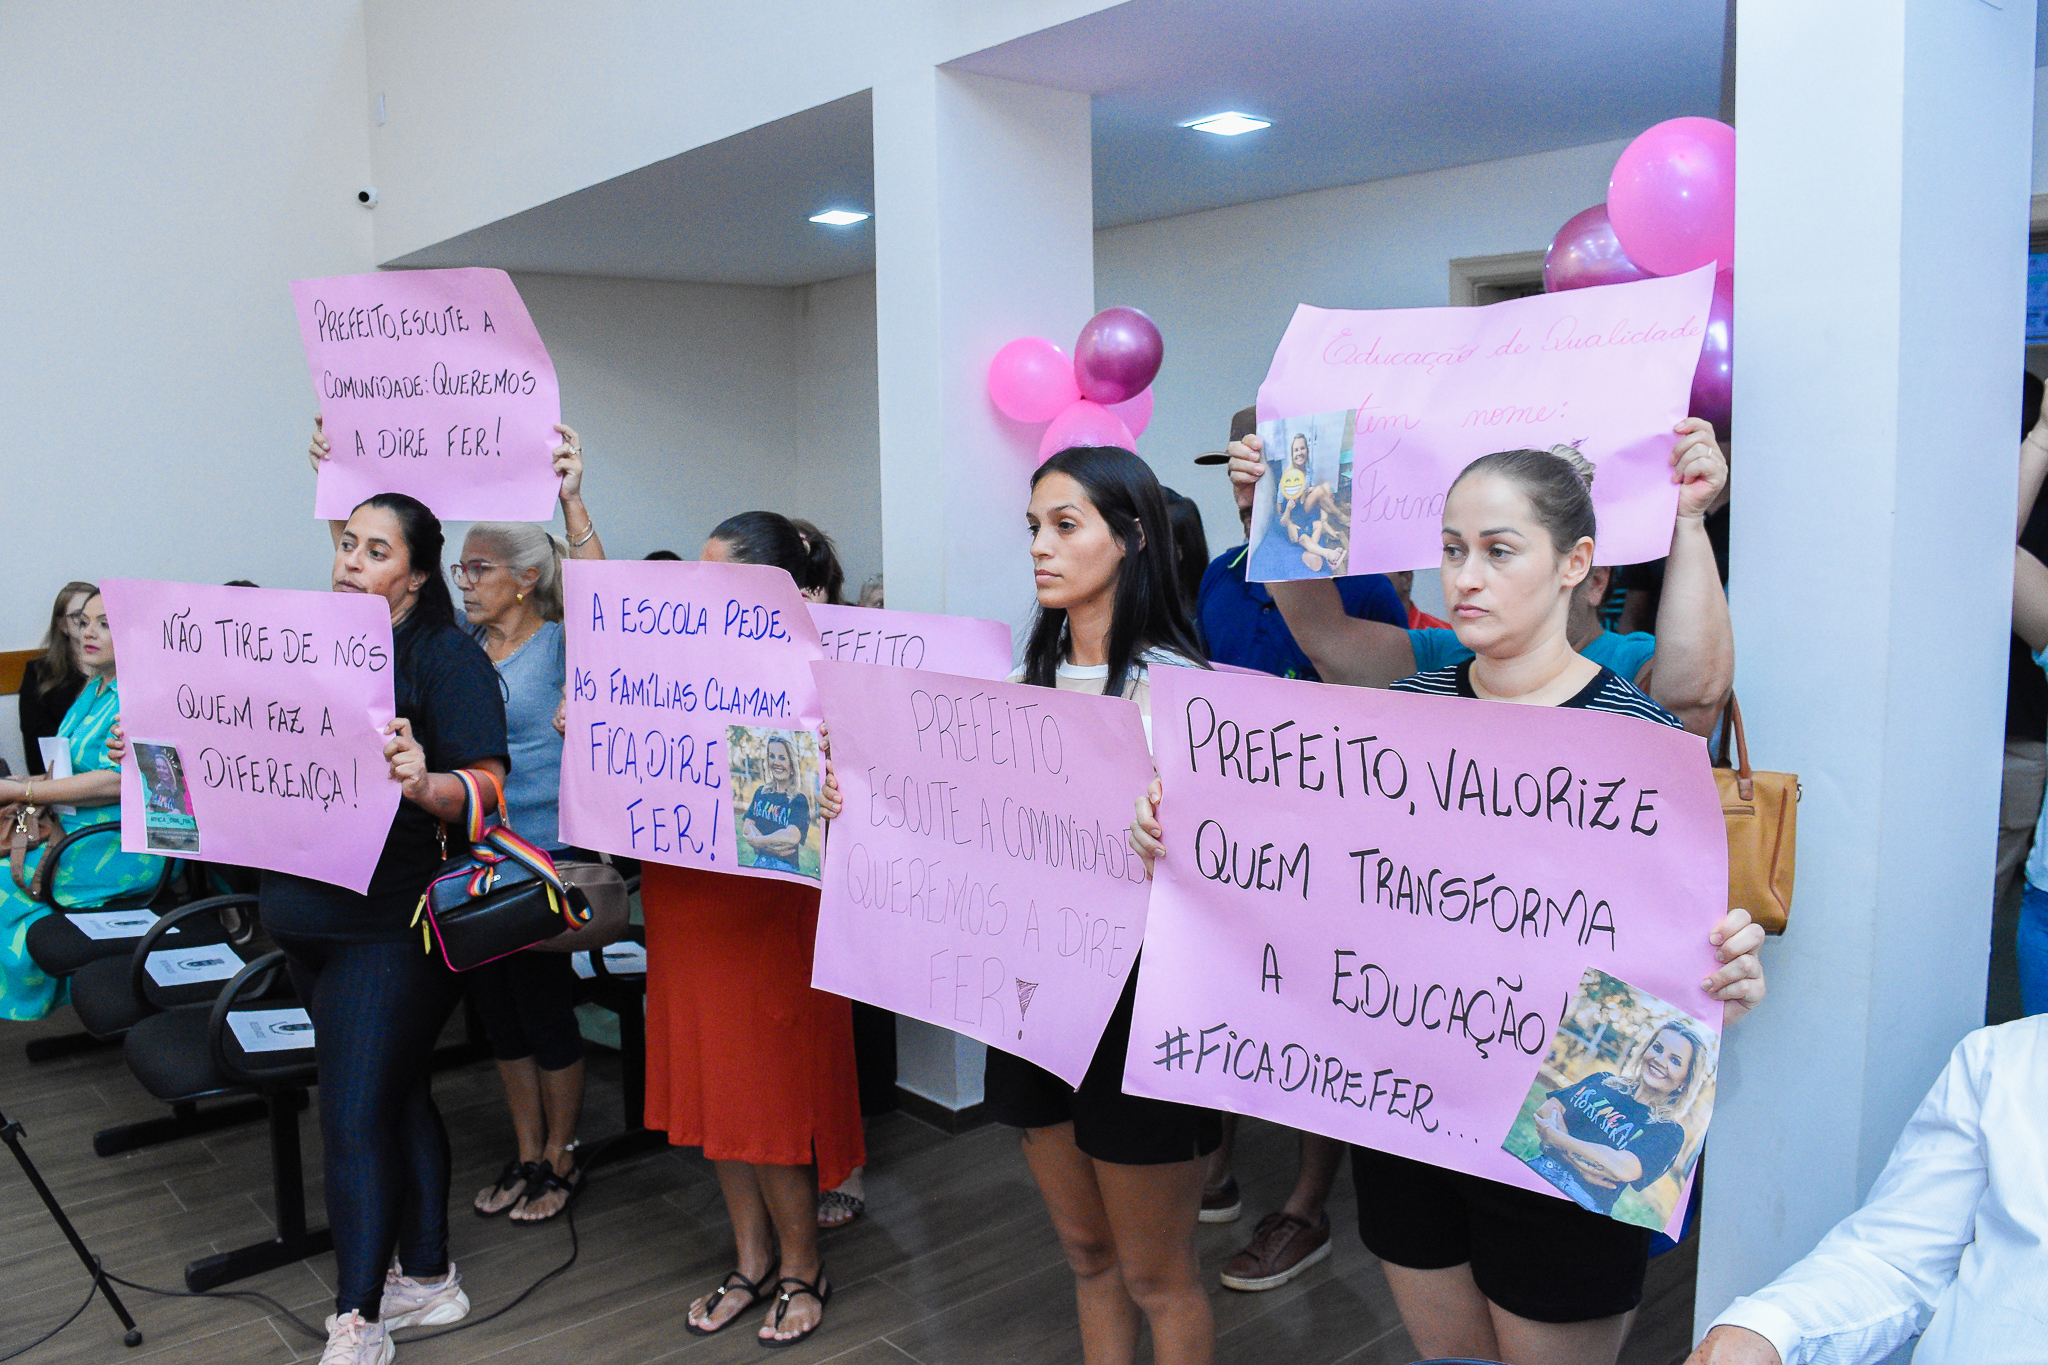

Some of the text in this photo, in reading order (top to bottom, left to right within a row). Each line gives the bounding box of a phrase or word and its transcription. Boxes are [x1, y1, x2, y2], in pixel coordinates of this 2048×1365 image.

[401, 305, 469, 336] ESCUTE
[483, 311, 496, 334] A
[1322, 315, 1703, 375] Educação de Qualidade
[324, 361, 536, 400] COMUNIDADE: QUEREMOS
[355, 416, 502, 459] A DIRE FER!
[1355, 393, 1569, 435] tem nome:
[1358, 439, 1443, 523] Ferna
[163, 607, 388, 672] NÃO TIRE DE NÓS
[592, 593, 791, 643] A ESCOLA PEDE,
[177, 684, 334, 737] QUEM FAZ A
[574, 667, 791, 718] AS FAMÍLIAS CLAMAM:
[644, 730, 721, 789] DIRE
[910, 689, 1070, 784] PREFEITO,
[1186, 697, 1659, 836] PREFEITO, VALORIZE
[626, 798, 719, 862] FER!
[868, 766, 972, 845] ESCUTE
[980, 798, 995, 853] A
[846, 843, 1126, 979] QUEREMOS A DIRE
[1195, 820, 1616, 952] QUEM TRANSFORMA
[1261, 942, 1283, 994] A
